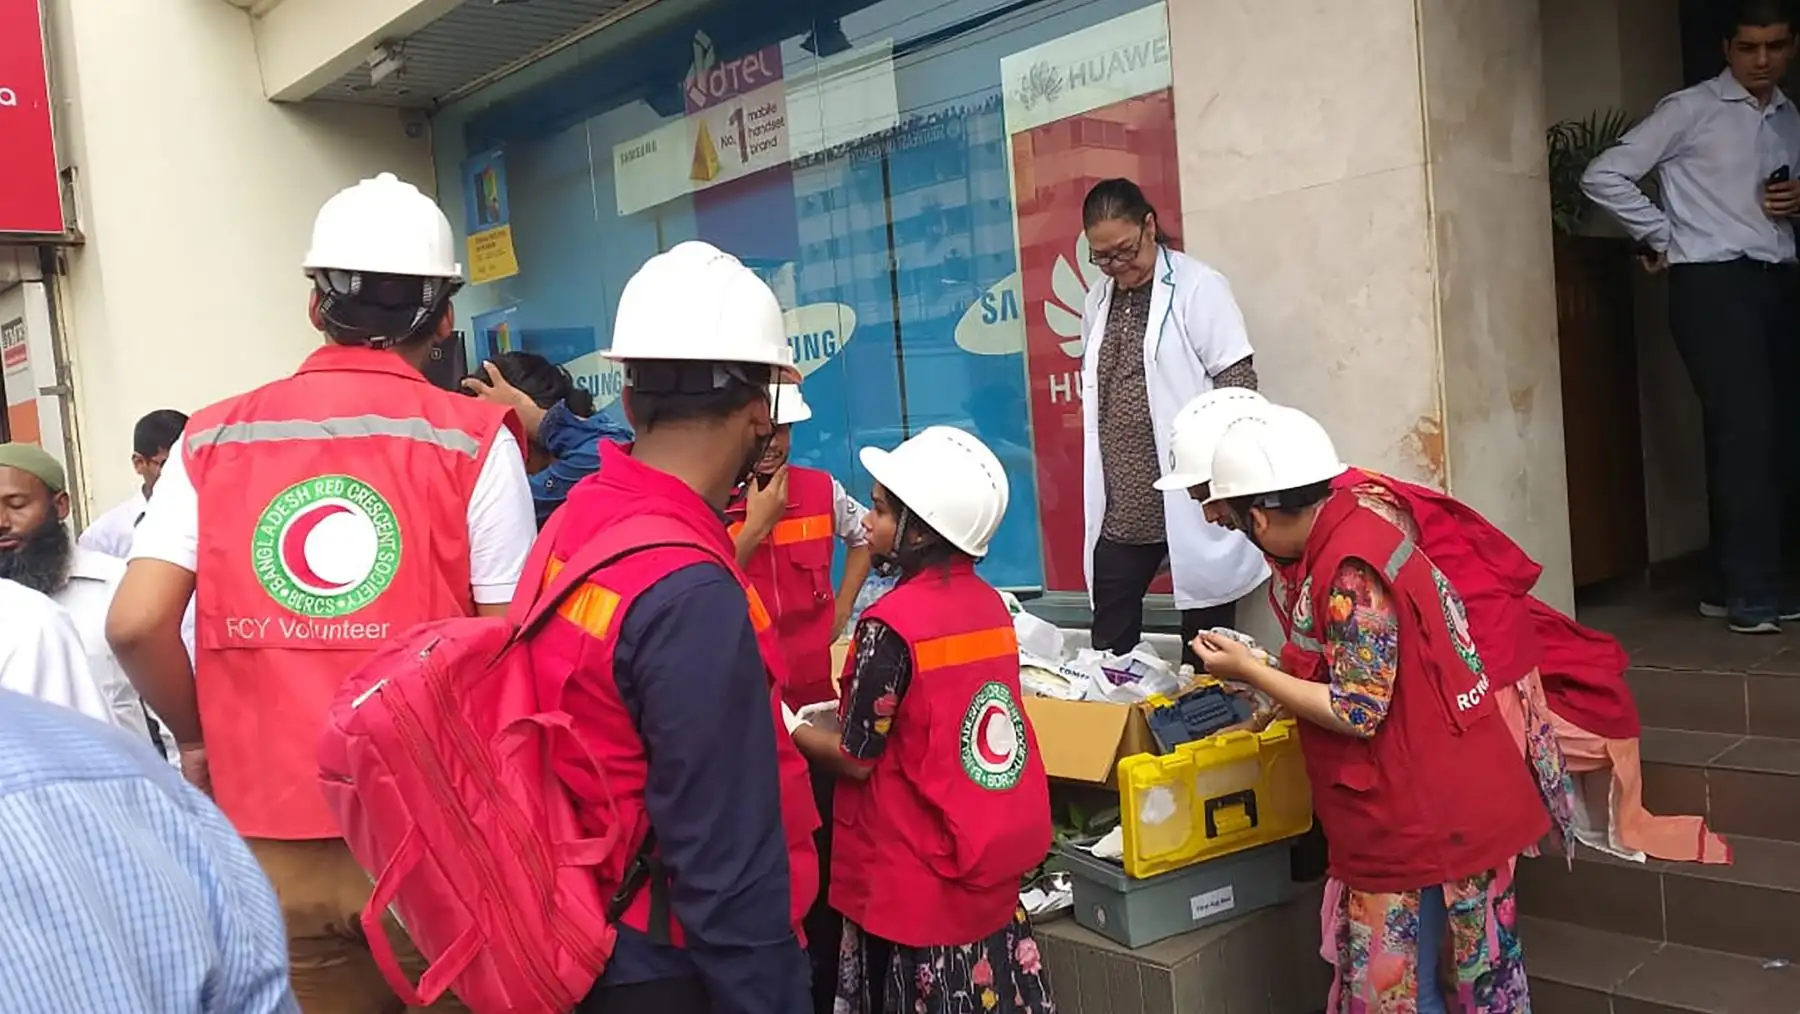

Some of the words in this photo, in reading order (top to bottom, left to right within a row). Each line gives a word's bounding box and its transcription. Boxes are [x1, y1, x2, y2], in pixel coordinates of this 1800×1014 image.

[748, 102, 777, 121] mobile
[729, 107, 749, 163] 1
[749, 115, 785, 138] handset
[750, 136, 777, 155] brand
[315, 480, 344, 496] RED
[347, 483, 396, 549] CRESCENT
[256, 485, 312, 592] BANGLADESH
[347, 551, 395, 609] SOCIETY
[278, 617, 390, 639] Volunteer
